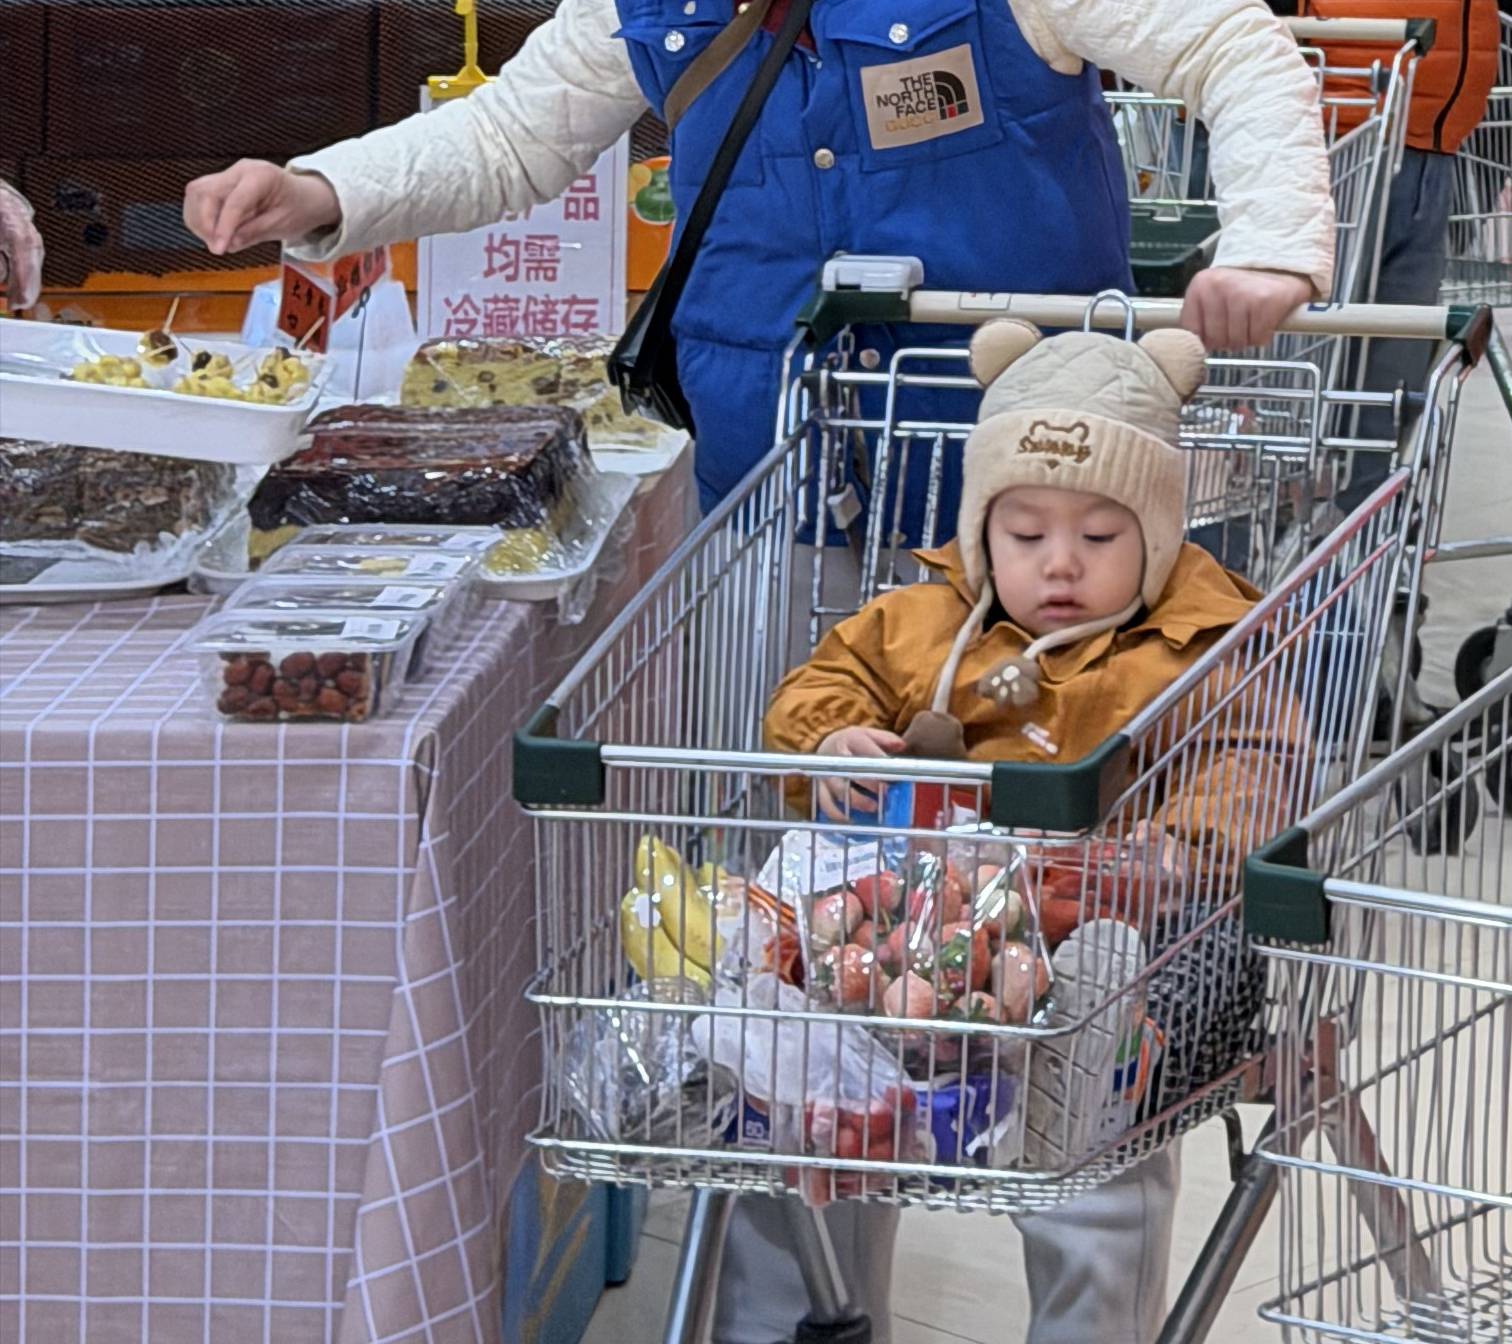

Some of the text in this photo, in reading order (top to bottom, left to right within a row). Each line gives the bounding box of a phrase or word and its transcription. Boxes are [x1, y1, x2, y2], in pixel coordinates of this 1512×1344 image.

[875, 82, 936, 108] NORTH
[899, 72, 933, 92] THE
[895, 98, 937, 119] FACE
[483, 233, 562, 283] 均需
[443, 294, 600, 340] 冷藏储存
